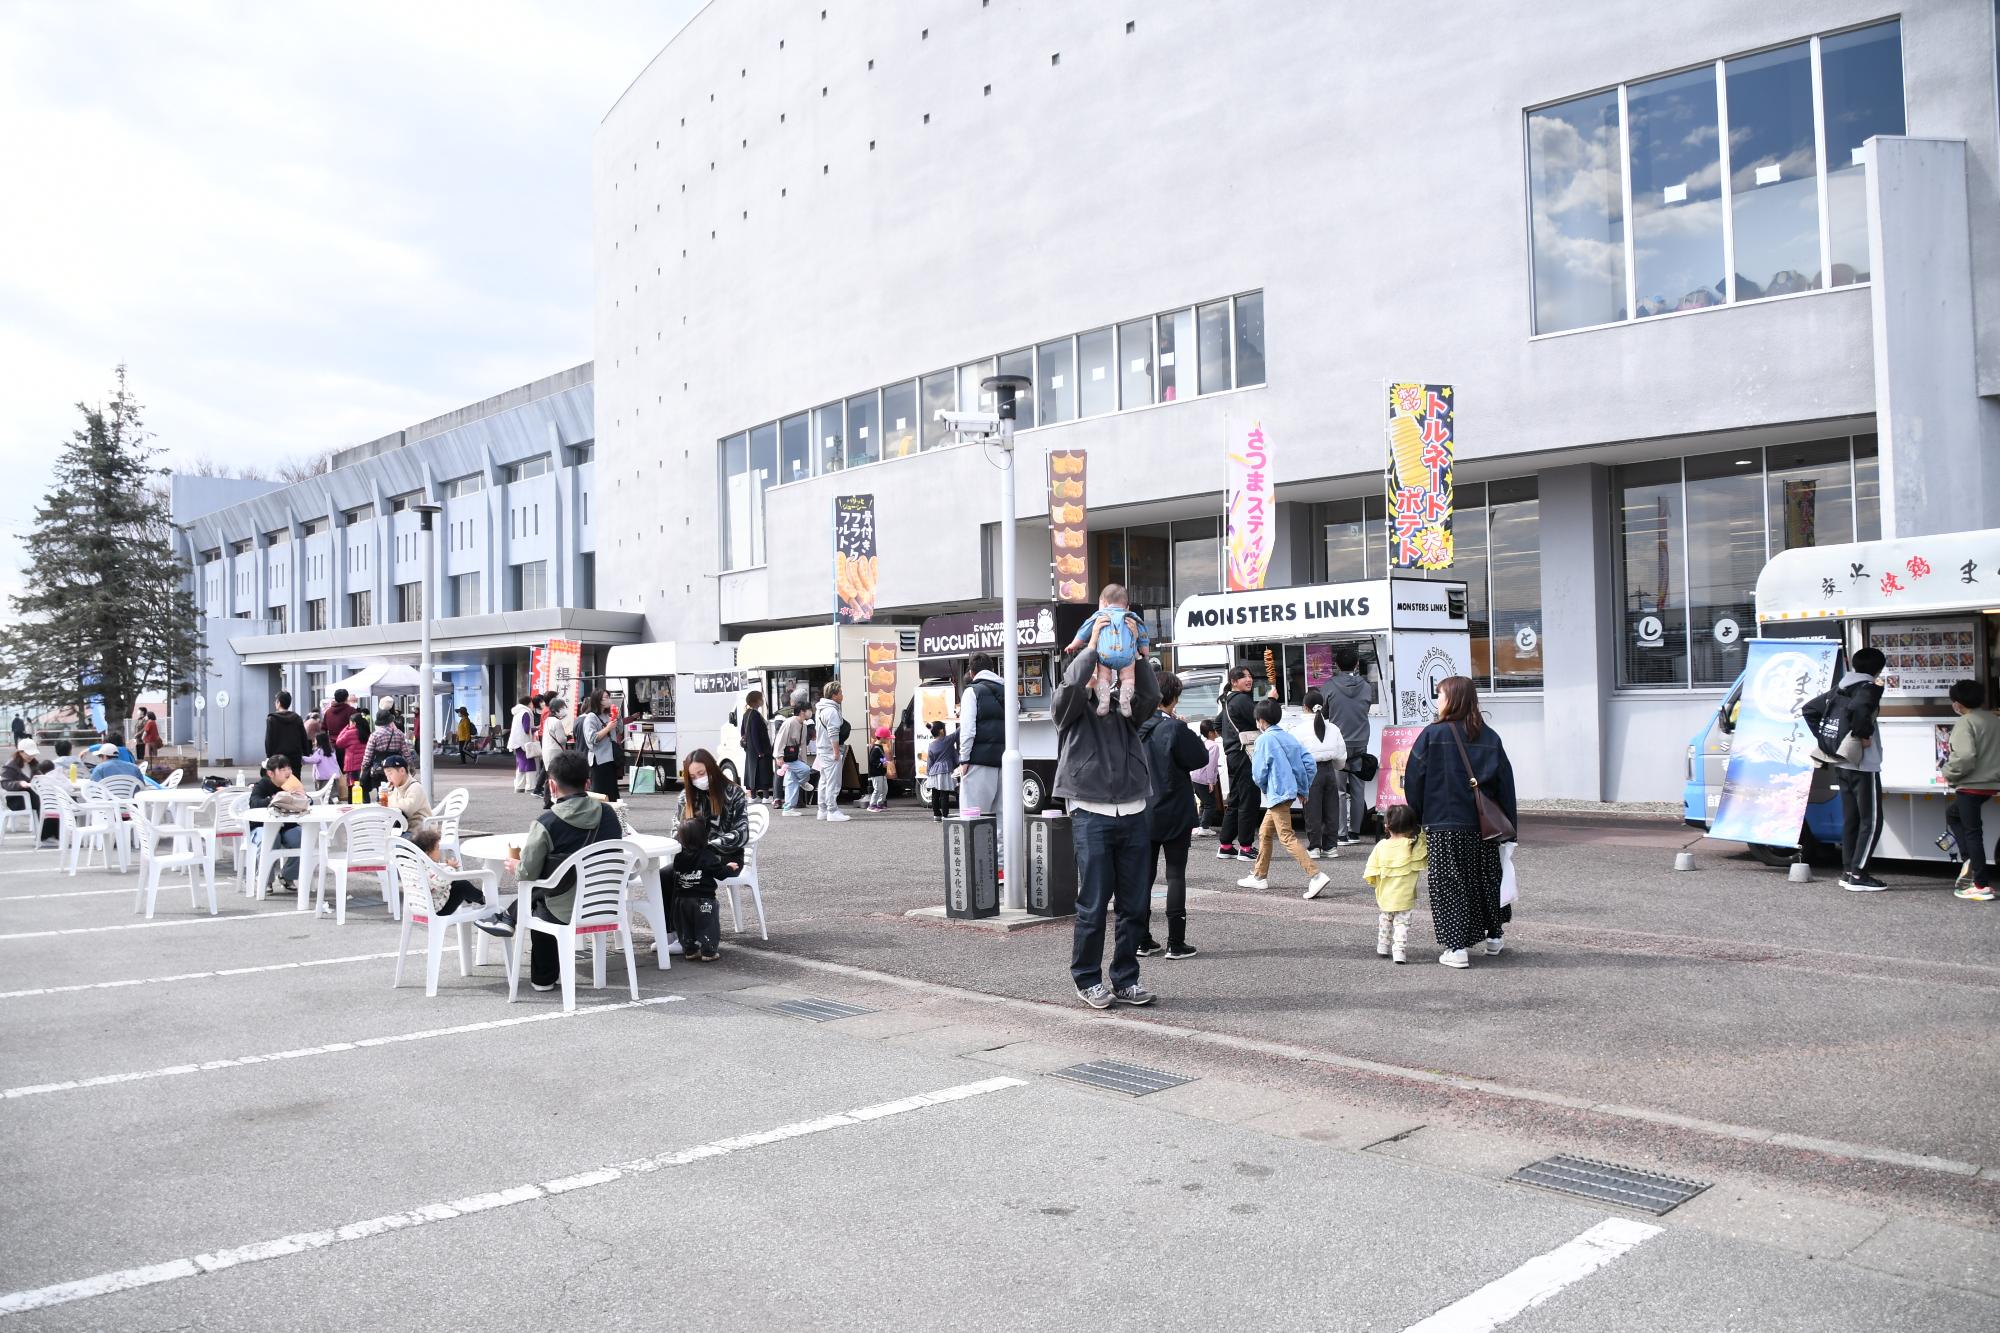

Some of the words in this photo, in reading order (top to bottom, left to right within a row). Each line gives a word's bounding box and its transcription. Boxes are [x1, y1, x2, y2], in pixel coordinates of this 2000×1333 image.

[1421, 391, 1449, 520] トルネード
[850, 511, 861, 562] フランク
[861, 510, 873, 553] 骨付き
[1396, 487, 1424, 565] ポテト
[1960, 558, 2000, 585] ま
[1187, 602, 1297, 628] MONSTERS
[1304, 597, 1370, 620] LINKS
[1397, 602, 1429, 612] MONSTERS
[1430, 603, 1447, 612] LINKS
[982, 628, 1037, 648] NYAKO
